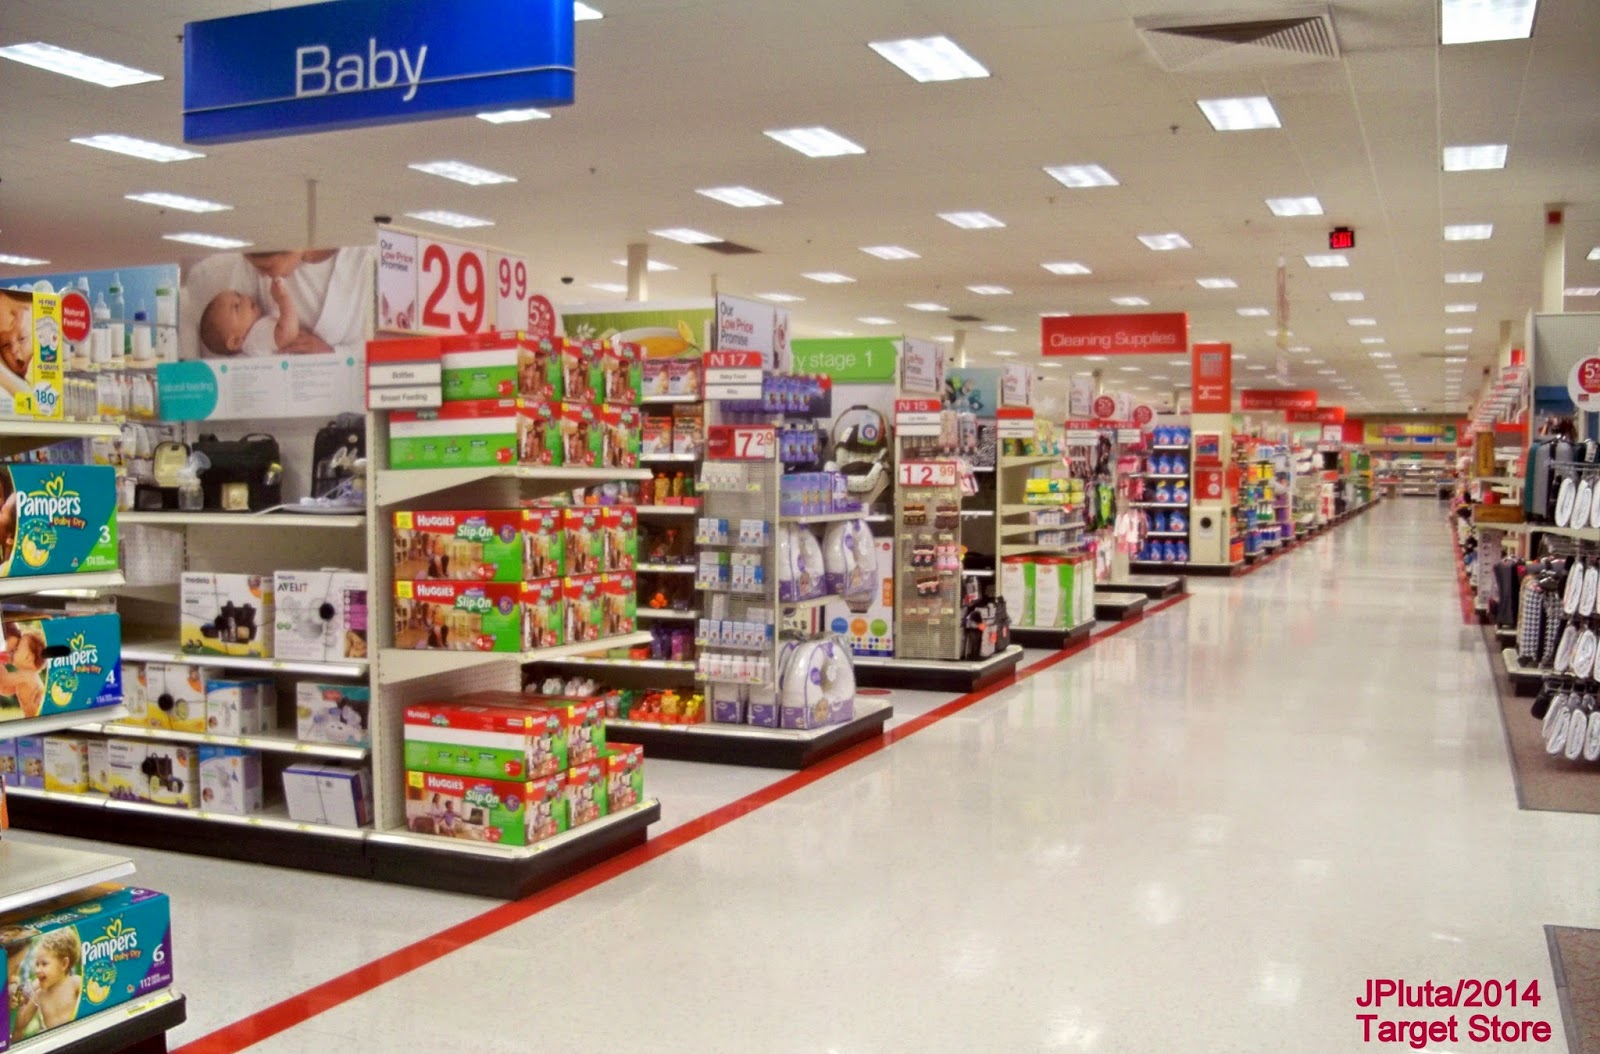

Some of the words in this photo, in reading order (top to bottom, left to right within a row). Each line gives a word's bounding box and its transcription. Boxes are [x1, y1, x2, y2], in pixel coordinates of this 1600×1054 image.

[296, 38, 428, 102] Baby
[380, 239, 393, 250] Our
[1331, 232, 1351, 248] EXIT
[381, 250, 395, 261] Low
[396, 252, 413, 264] Price
[381, 260, 408, 272] Promise
[422, 244, 485, 334] 29
[500, 258, 527, 300] 99
[63, 307, 85, 317] Natural
[529, 301, 550, 325] 5%
[721, 302, 734, 316] Our
[63, 318, 86, 329] Feeding
[721, 317, 735, 330] Low
[736, 318, 753, 334] Price
[721, 329, 748, 346] Promise
[1050, 333, 1111, 349] Cleaning
[1115, 331, 1176, 348] Supplies
[710, 354, 724, 366] N
[729, 353, 748, 366] 17
[809, 353, 856, 371] stage
[863, 350, 873, 368] 1
[392, 371, 414, 379] Bottles
[35, 389, 56, 405] 180
[402, 394, 428, 402] Feeding
[900, 402, 909, 411] N
[913, 402, 928, 411] 15
[738, 433, 753, 457] 7
[757, 432, 774, 446] 29
[940, 466, 954, 477] 99
[16, 491, 81, 523] Pampers
[53, 517, 71, 528] Baby
[73, 518, 86, 530] Dry
[99, 525, 111, 544] 3
[457, 524, 493, 541] Slip-On
[456, 595, 493, 612] Slip-On
[105, 669, 116, 685] 4
[465, 790, 500, 808] Slip-On
[81, 931, 137, 965] Pampers
[153, 943, 165, 962] 6
